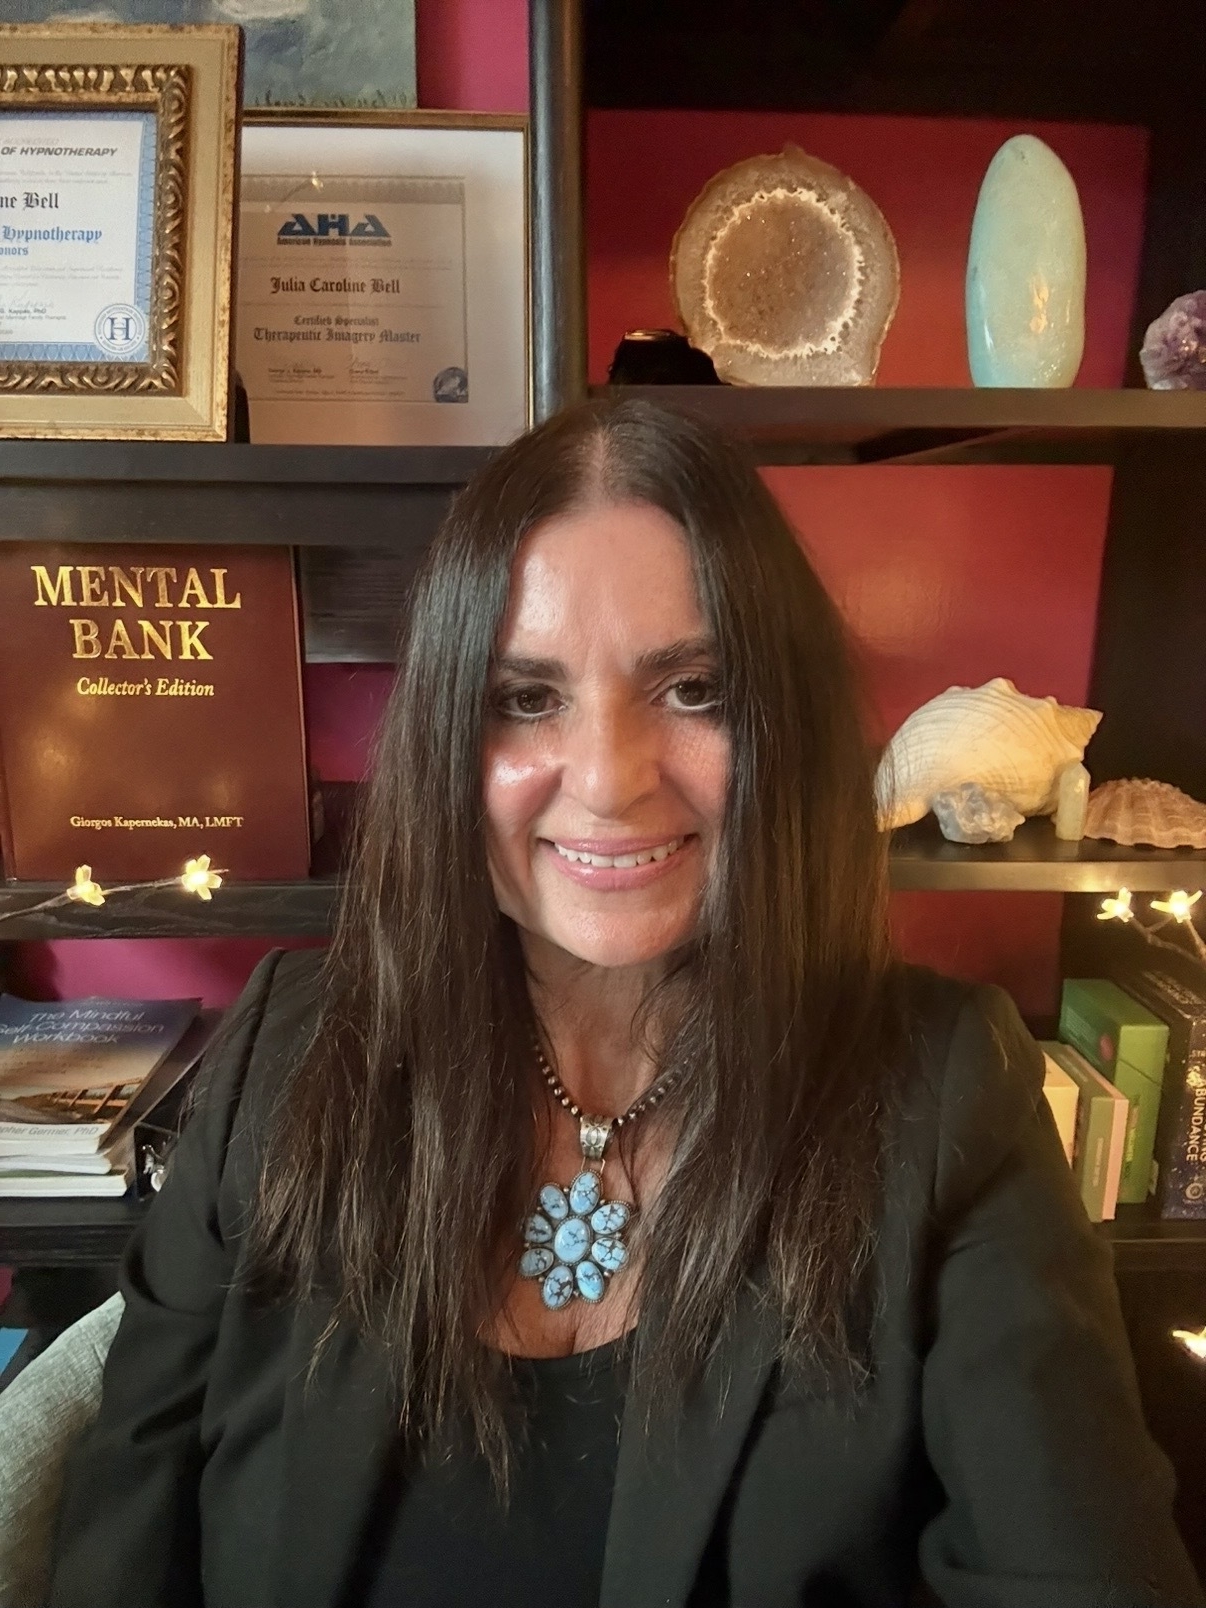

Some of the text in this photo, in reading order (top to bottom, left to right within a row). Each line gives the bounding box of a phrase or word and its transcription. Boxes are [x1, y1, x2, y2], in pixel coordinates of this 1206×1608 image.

[0, 146, 118, 156] OF HYPNOTHERAPY
[23, 192, 59, 210] Bell
[277, 213, 391, 237] AHA
[2, 225, 103, 244] Hypnotherapy
[270, 276, 401, 294] Julia Caroline Bell
[253, 327, 422, 344] Therapeutic Imagery Master
[30, 565, 242, 609] MENTAL
[69, 618, 214, 661] BANK
[77, 677, 215, 697] Collector's Edition
[70, 816, 244, 830] Giorgos Kapernekas, MA, LMFT
[68, 1009, 146, 1021] Mindful
[12, 1031, 119, 1044] Workbook
